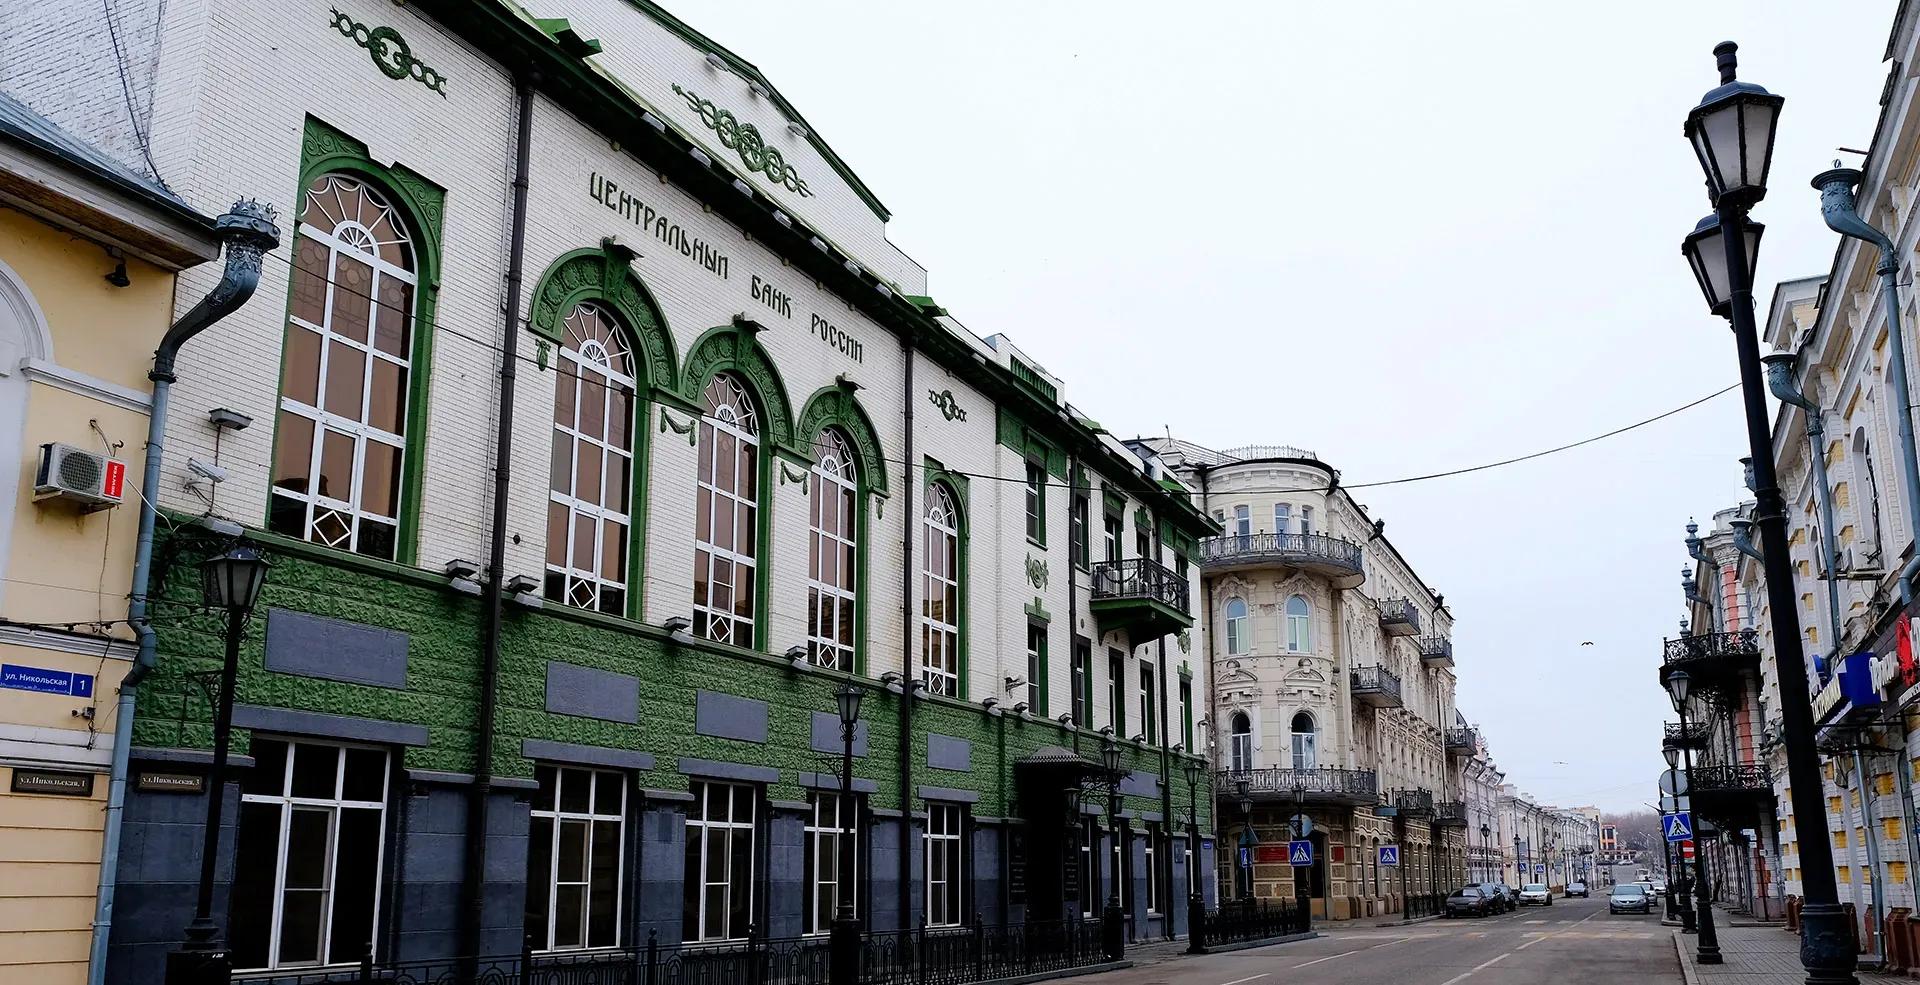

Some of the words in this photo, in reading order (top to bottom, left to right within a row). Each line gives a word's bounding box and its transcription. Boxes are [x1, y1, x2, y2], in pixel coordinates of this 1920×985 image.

[751, 274, 792, 319] БАНК
[5, 673, 18, 681] ул.
[19, 673, 68, 686] Никольская
[80, 679, 86, 691] 1
